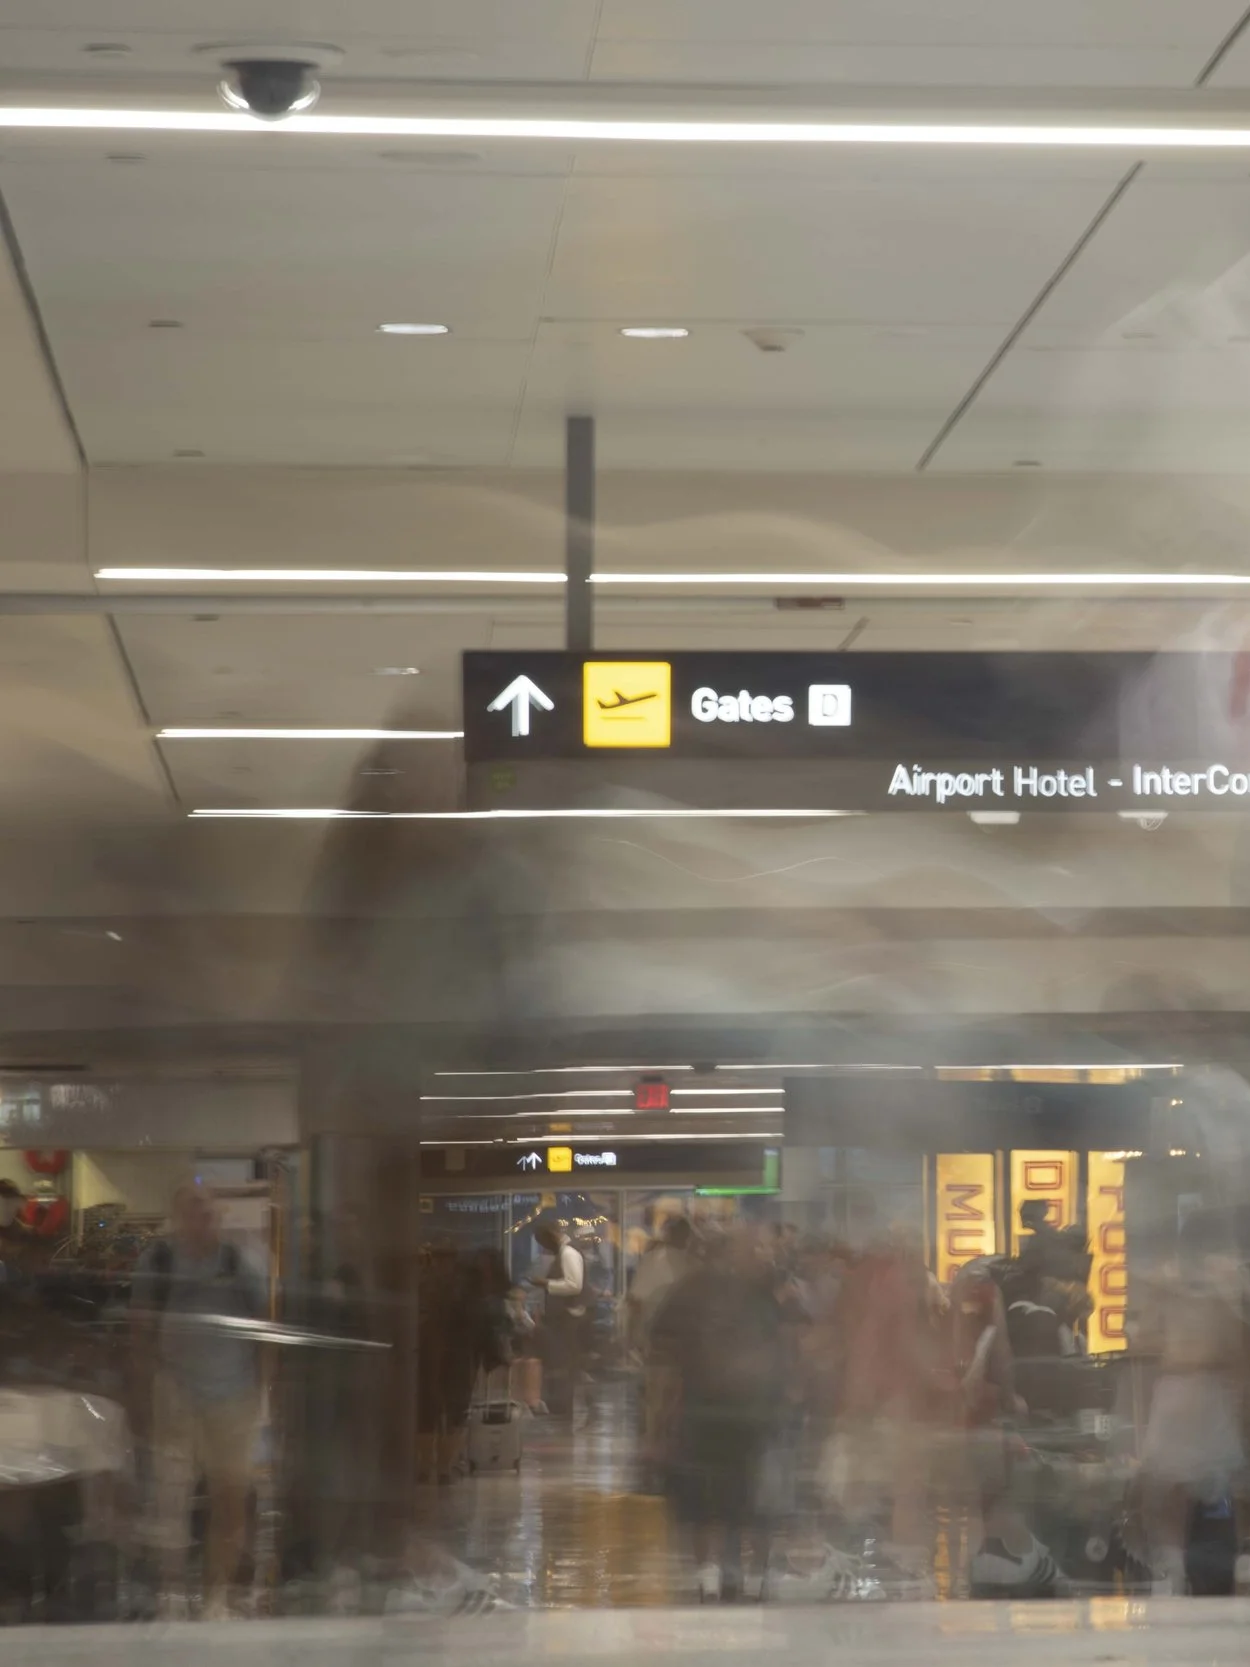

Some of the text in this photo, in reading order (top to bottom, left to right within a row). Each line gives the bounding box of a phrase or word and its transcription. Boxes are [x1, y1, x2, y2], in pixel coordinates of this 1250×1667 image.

[691, 686, 794, 723] Gates
[888, 764, 1003, 803] Airport
[1014, 765, 1098, 797] Hotel
